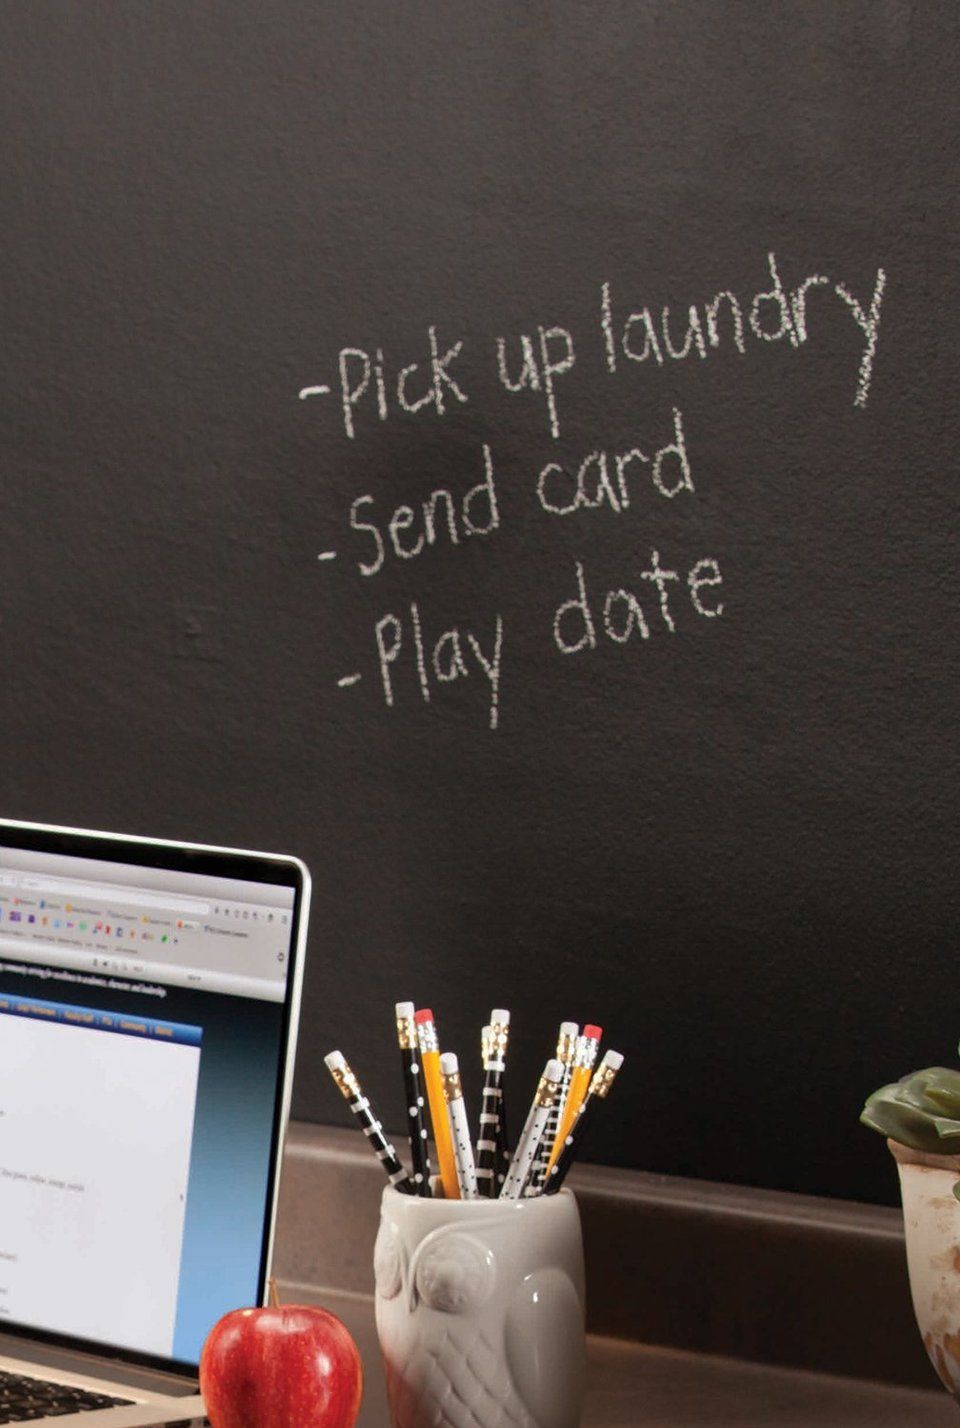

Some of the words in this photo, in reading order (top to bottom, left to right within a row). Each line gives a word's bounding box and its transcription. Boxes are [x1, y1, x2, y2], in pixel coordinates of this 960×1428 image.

[497, 326, 575, 438] up
[601, 252, 886, 406] laundry
[537, 407, 694, 515] card
[553, 550, 723, 653] date
